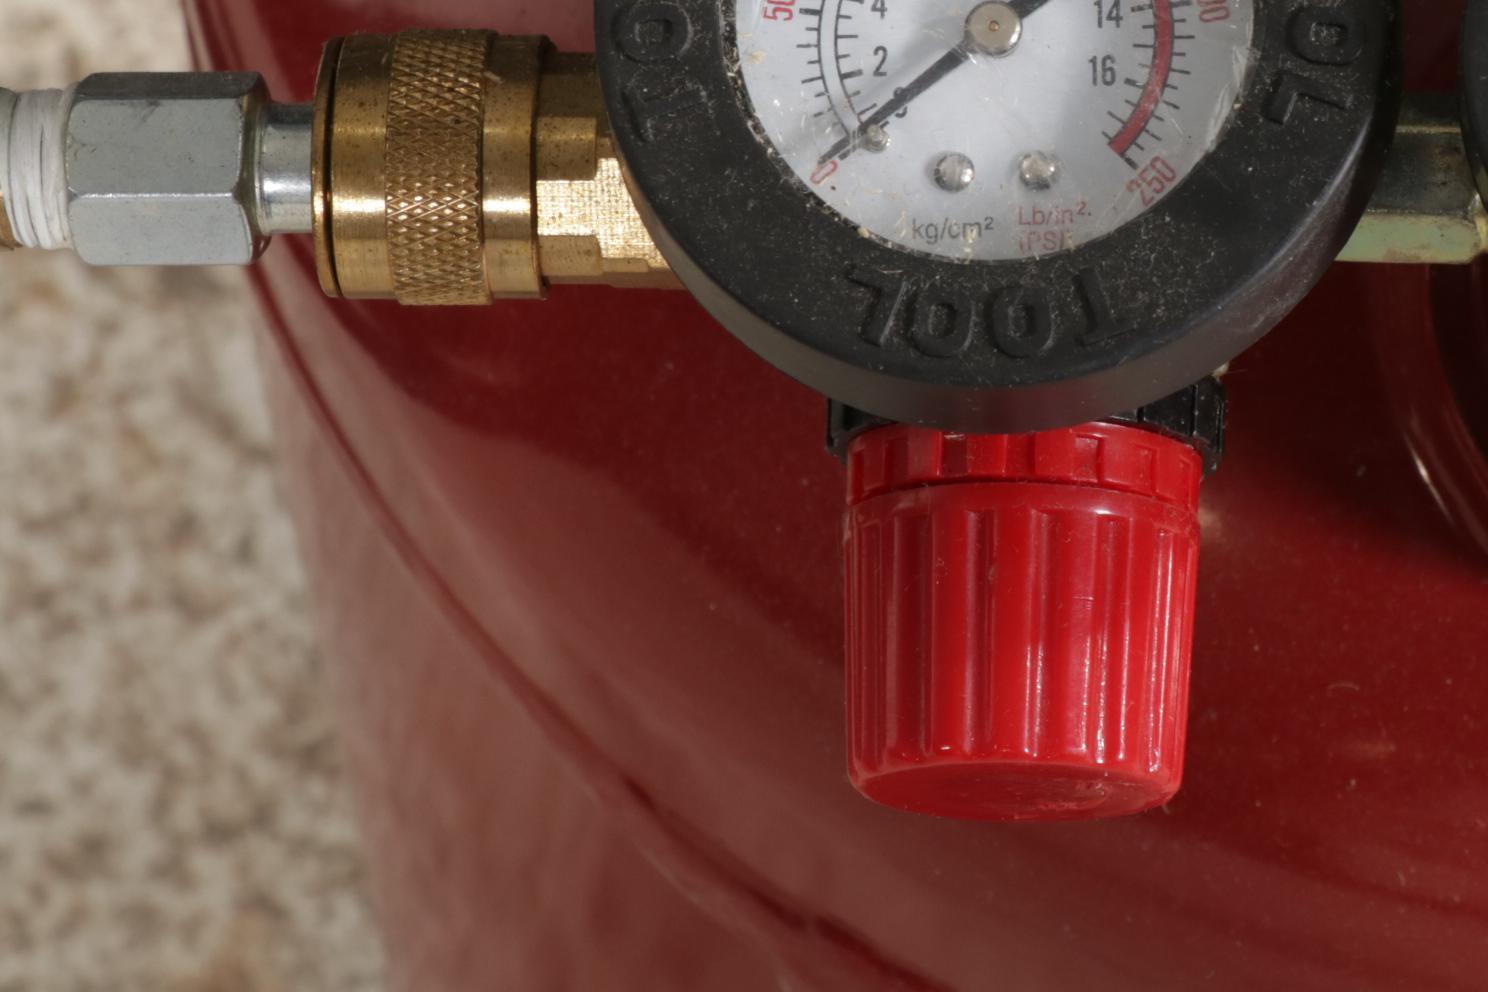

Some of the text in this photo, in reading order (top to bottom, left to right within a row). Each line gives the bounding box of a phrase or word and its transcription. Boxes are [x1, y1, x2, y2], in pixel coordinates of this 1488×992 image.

[873, 46, 888, 77] 2
[1088, 55, 1116, 87] 16
[1126, 155, 1178, 208] 250
[846, 264, 1137, 359] TOOL
